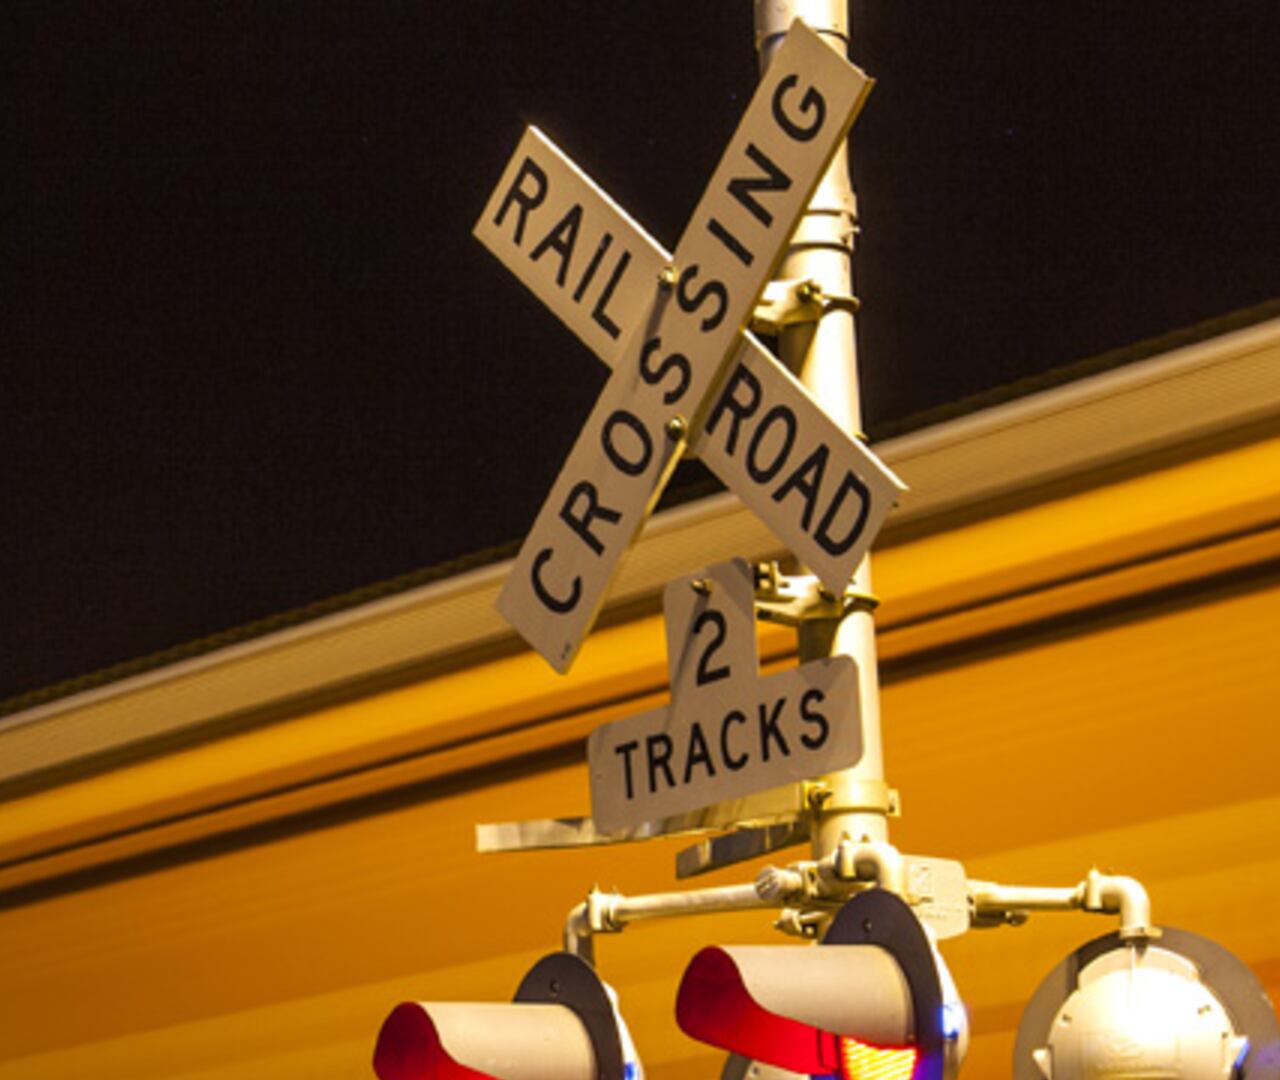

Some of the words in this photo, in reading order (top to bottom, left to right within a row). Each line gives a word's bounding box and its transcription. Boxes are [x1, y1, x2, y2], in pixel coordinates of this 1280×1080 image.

[493, 157, 632, 340] RAIL
[705, 364, 871, 556] ROAD
[531, 74, 827, 615] CROSSING
[615, 688, 831, 800] TRACKS
[692, 609, 731, 686] 2
